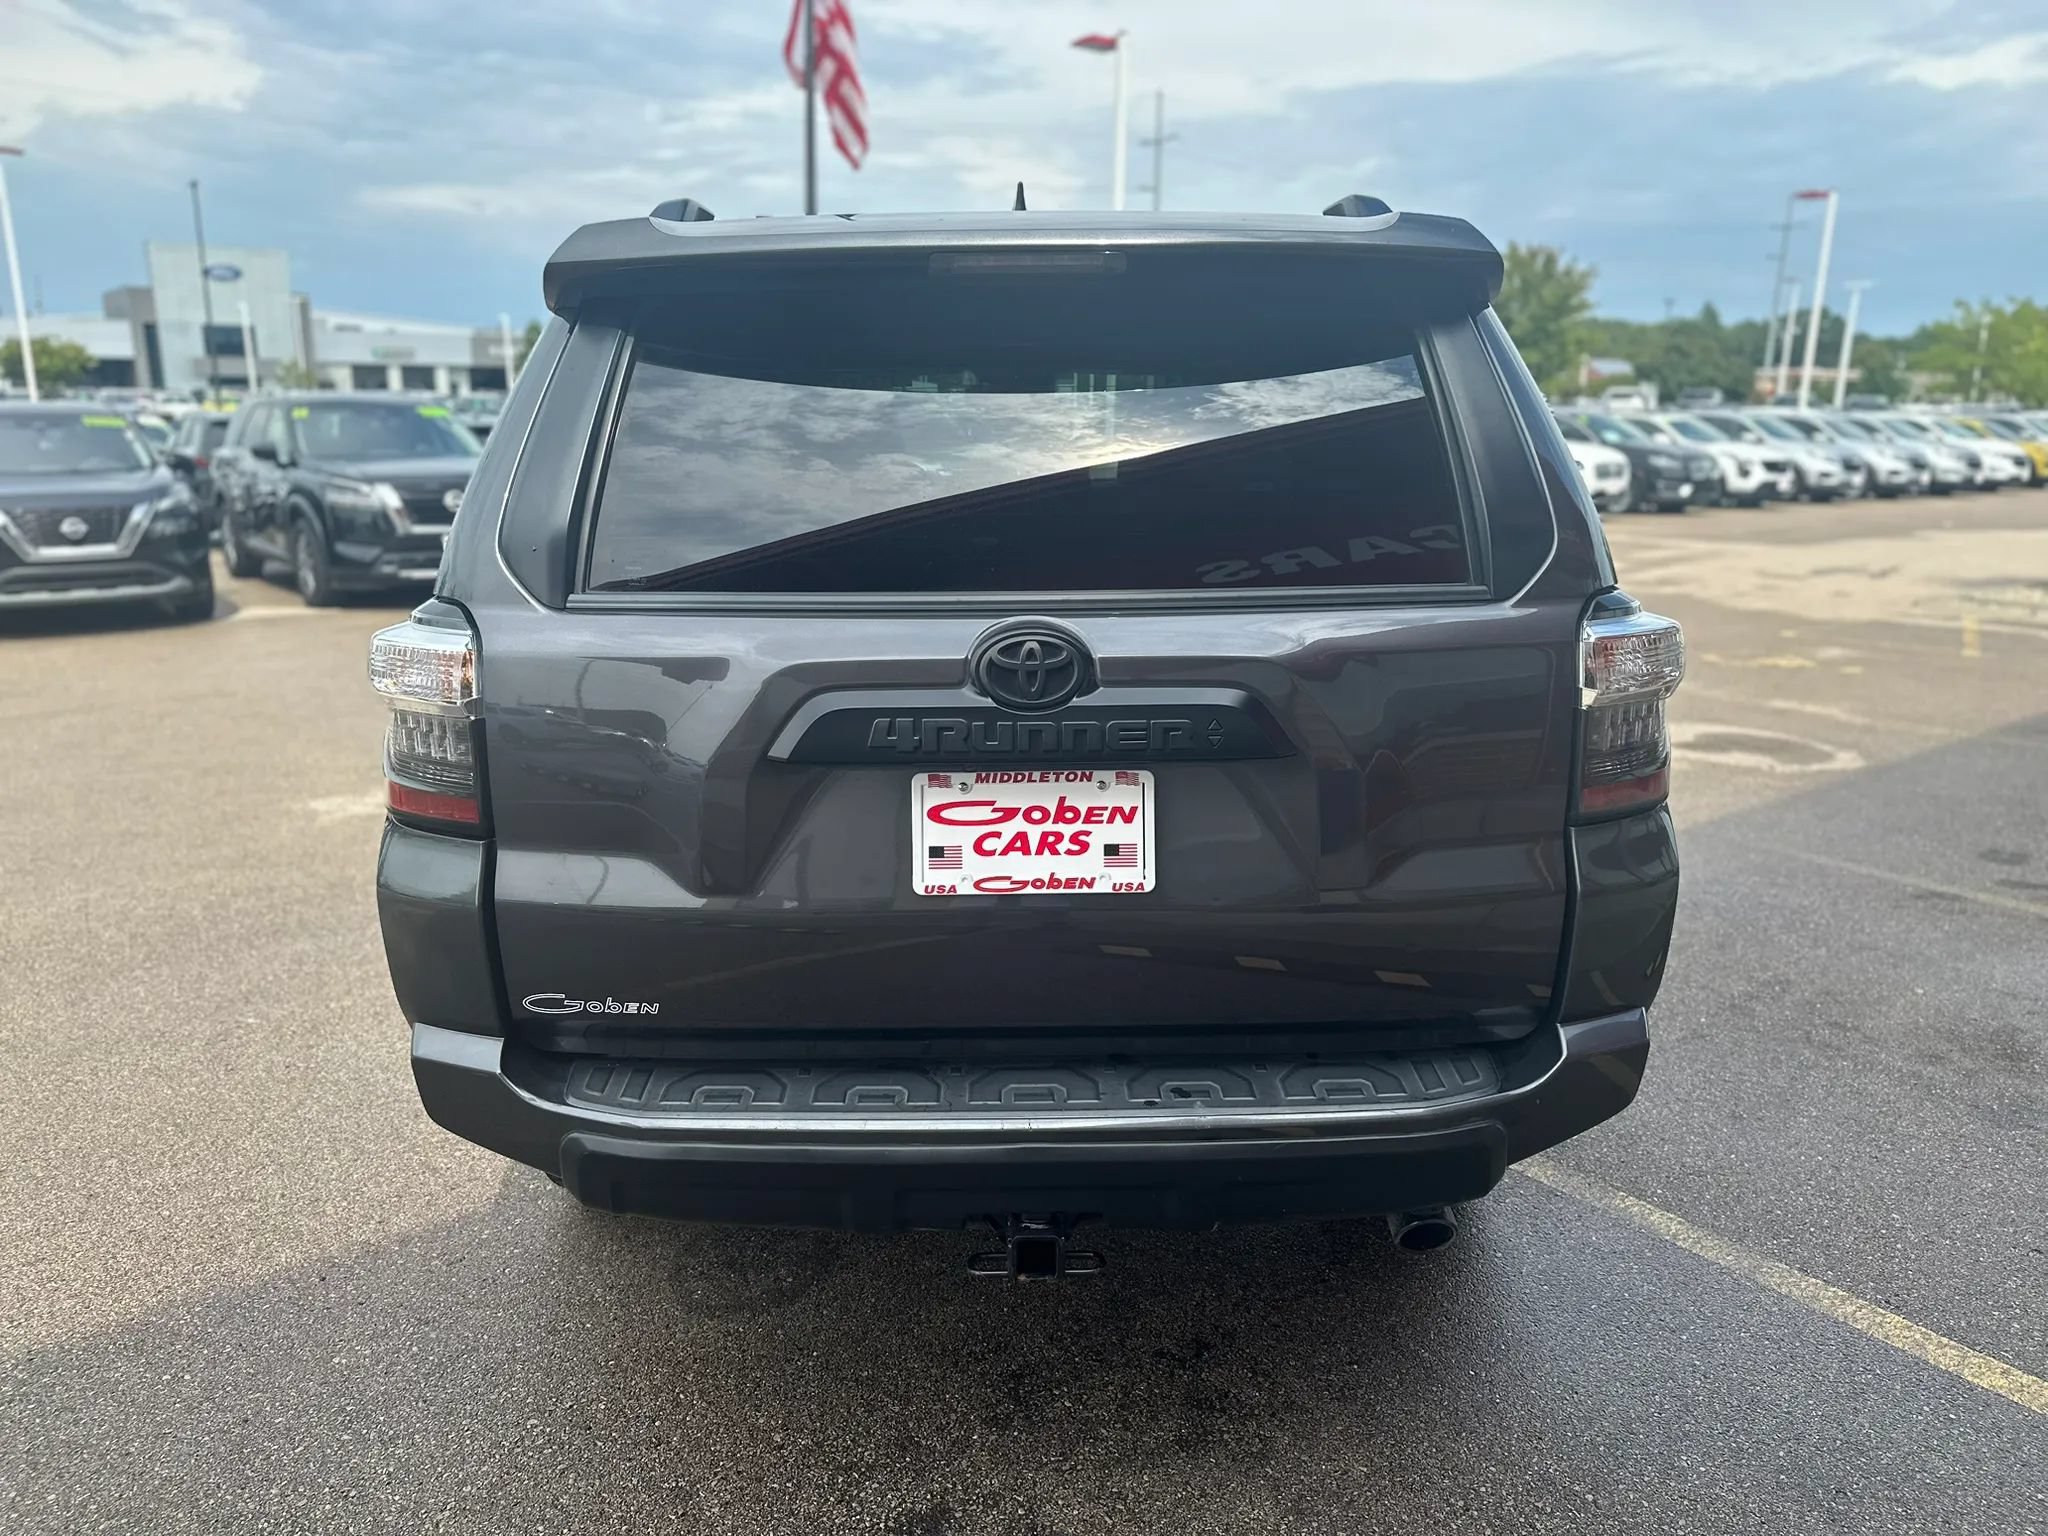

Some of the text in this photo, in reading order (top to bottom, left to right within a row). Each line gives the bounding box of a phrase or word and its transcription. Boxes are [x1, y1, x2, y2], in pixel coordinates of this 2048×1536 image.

[868, 717, 1195, 754] 4RUNNER
[975, 771, 1093, 784] MIDDLETON
[973, 830, 1092, 857] CARS
[924, 885, 957, 895] USA
[1112, 882, 1145, 892] USA
